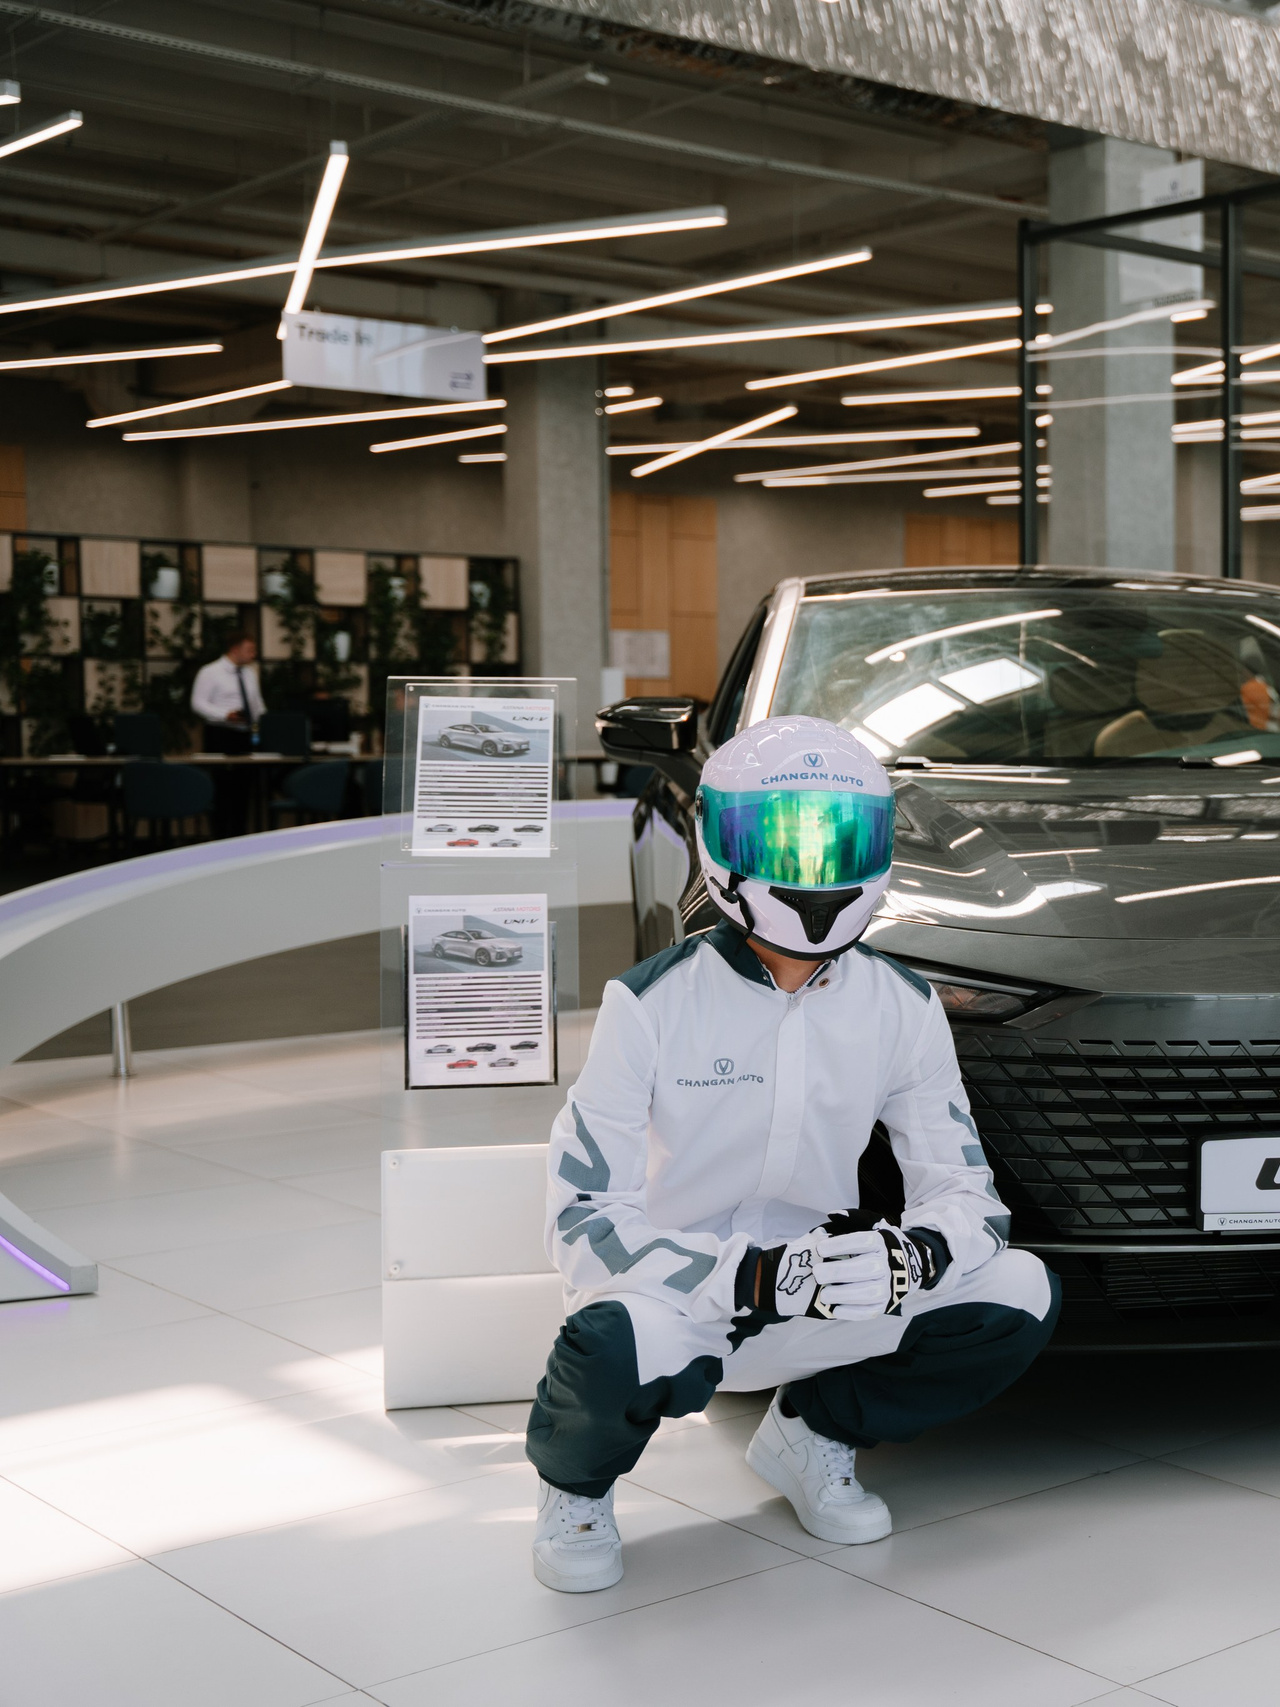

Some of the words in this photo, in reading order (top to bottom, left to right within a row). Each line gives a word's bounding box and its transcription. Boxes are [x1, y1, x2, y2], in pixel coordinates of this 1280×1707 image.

[296, 322, 349, 346] Trade
[761, 772, 829, 785] CHANGAN
[831, 774, 864, 787] AUTO
[676, 1078, 735, 1087] CHANGAN
[737, 1074, 764, 1084] AUTO
